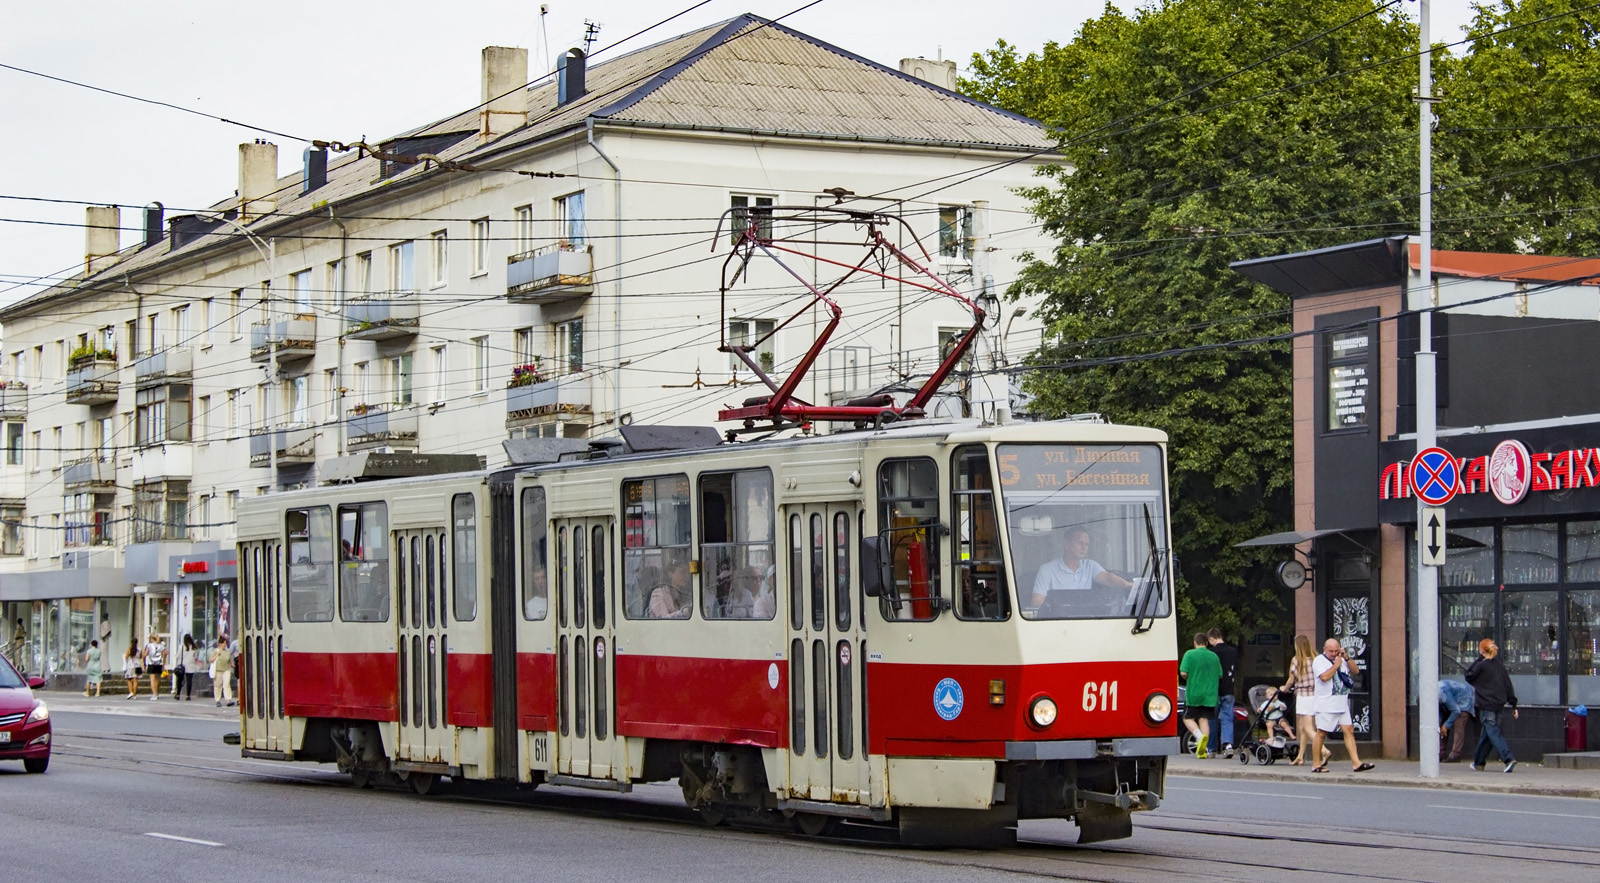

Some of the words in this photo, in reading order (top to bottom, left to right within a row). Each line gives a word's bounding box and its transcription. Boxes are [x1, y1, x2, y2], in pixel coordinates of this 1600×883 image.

[1044, 451, 1070, 466] ул.
[1074, 448, 1140, 465] Дюнная
[1000, 454, 1020, 486] 5
[1036, 473, 1061, 488] ул.
[1066, 470, 1150, 486] Бассейная
[1082, 680, 1118, 712] 611
[535, 738, 548, 762] 611
